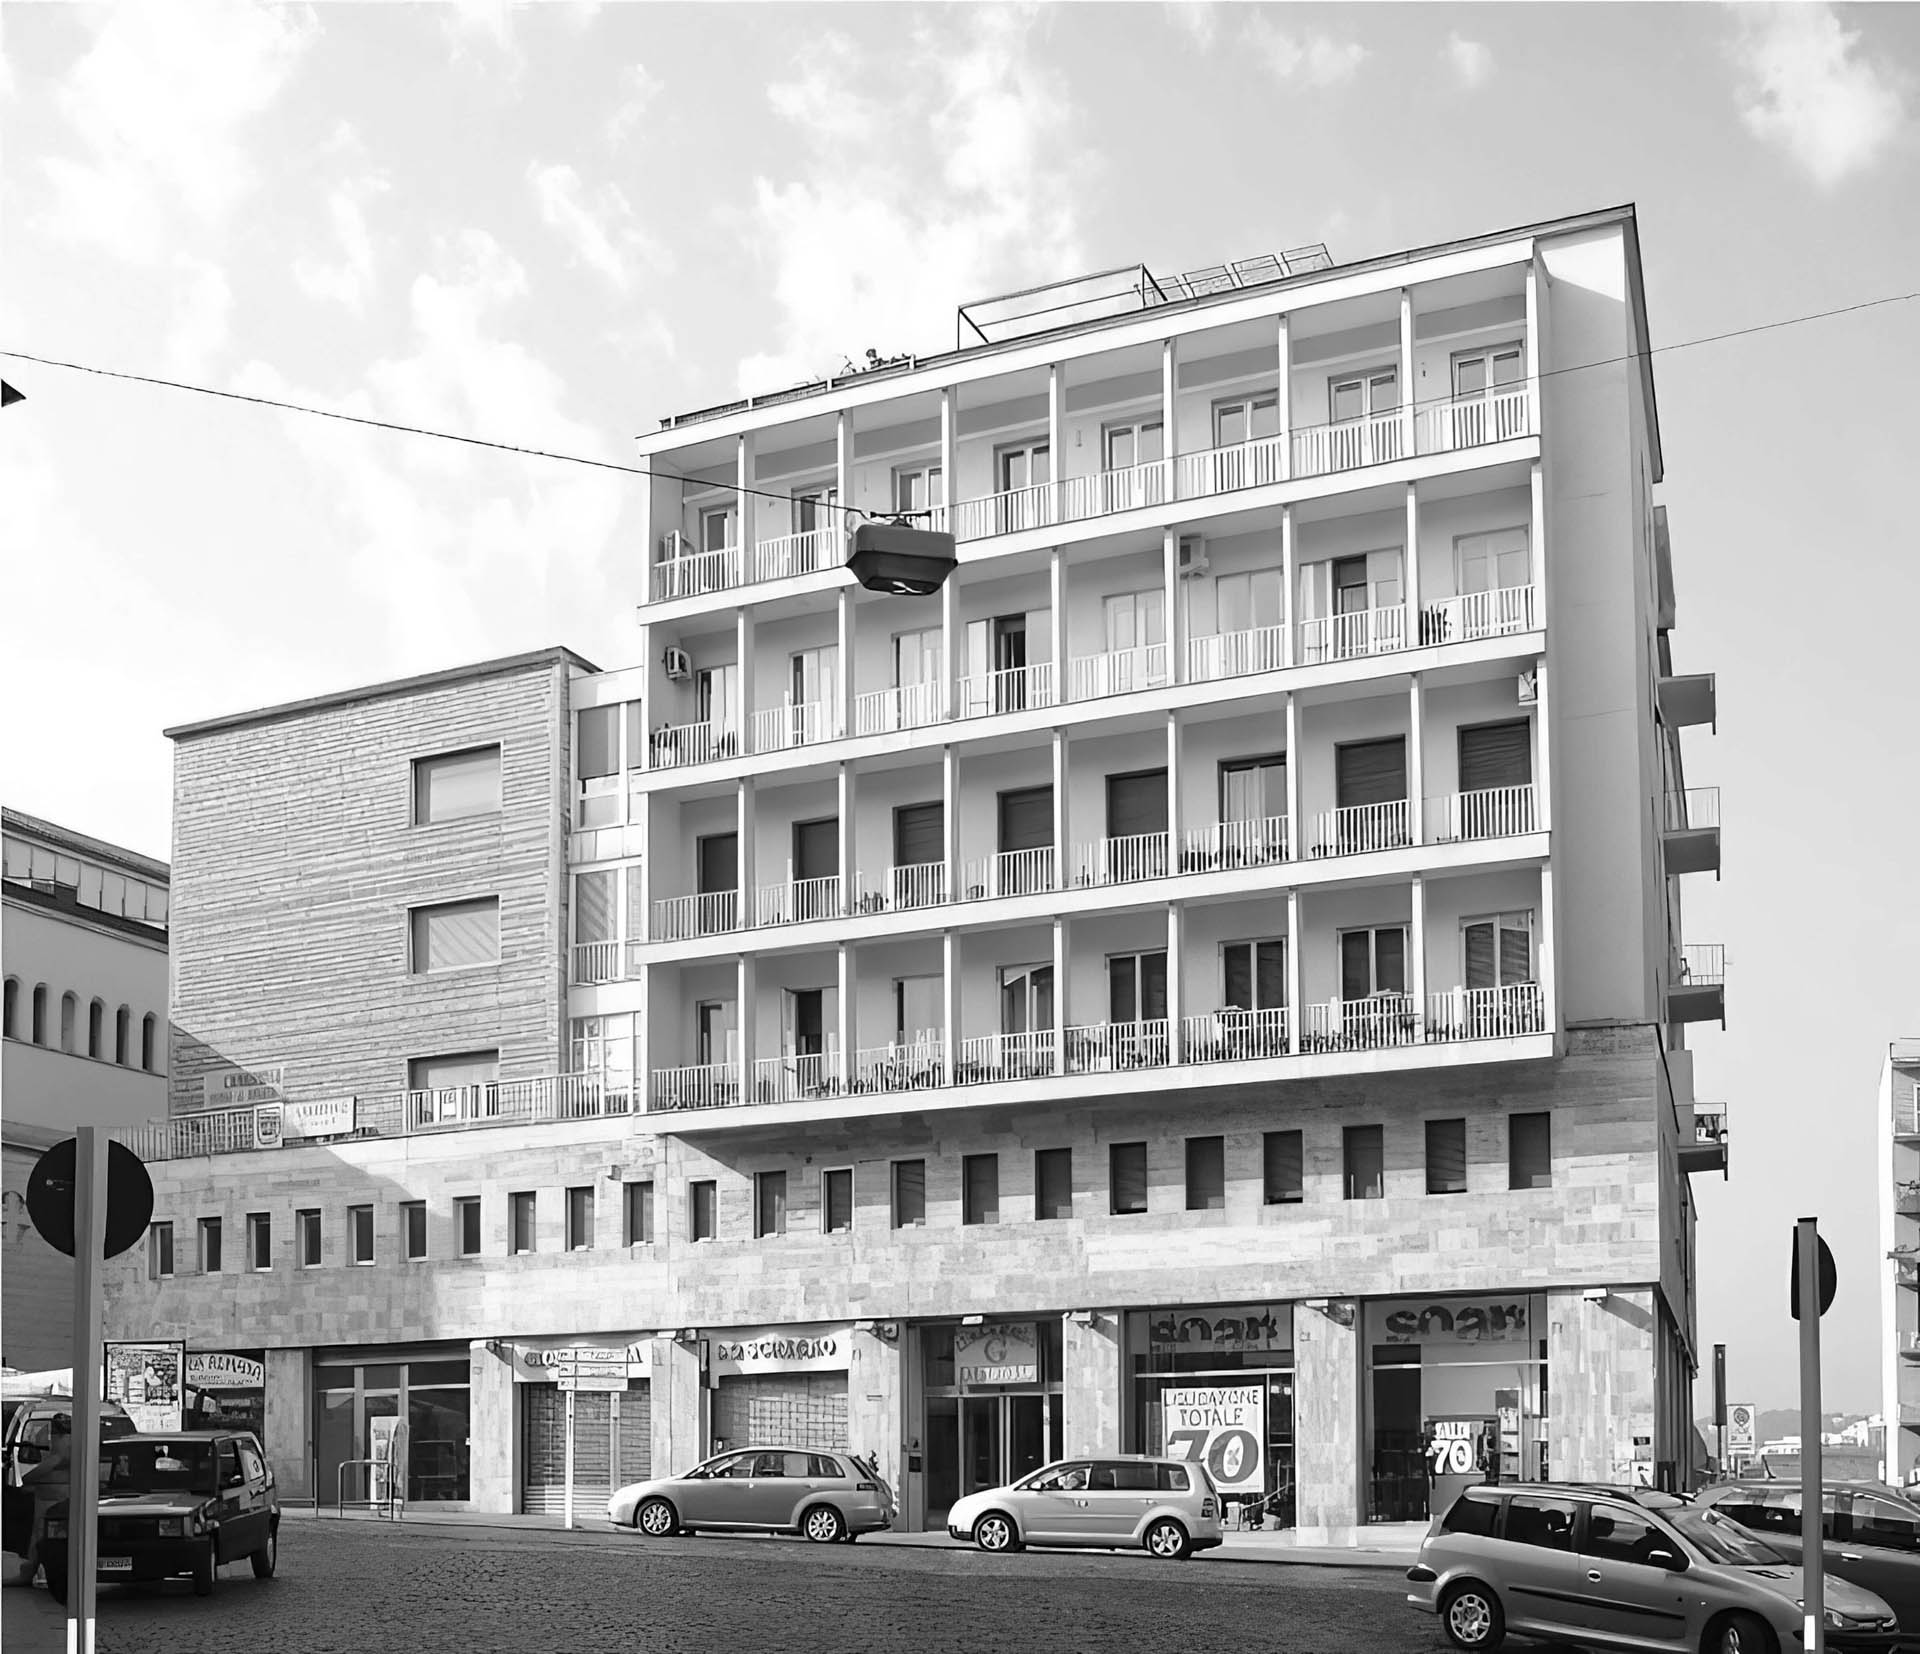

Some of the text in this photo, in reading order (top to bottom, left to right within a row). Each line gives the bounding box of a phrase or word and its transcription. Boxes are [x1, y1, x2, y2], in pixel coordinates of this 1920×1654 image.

[1180, 1408, 1243, 1426] TOTALE
[1168, 1430, 1259, 1484] 70
[1431, 1440, 1472, 1474] 70
